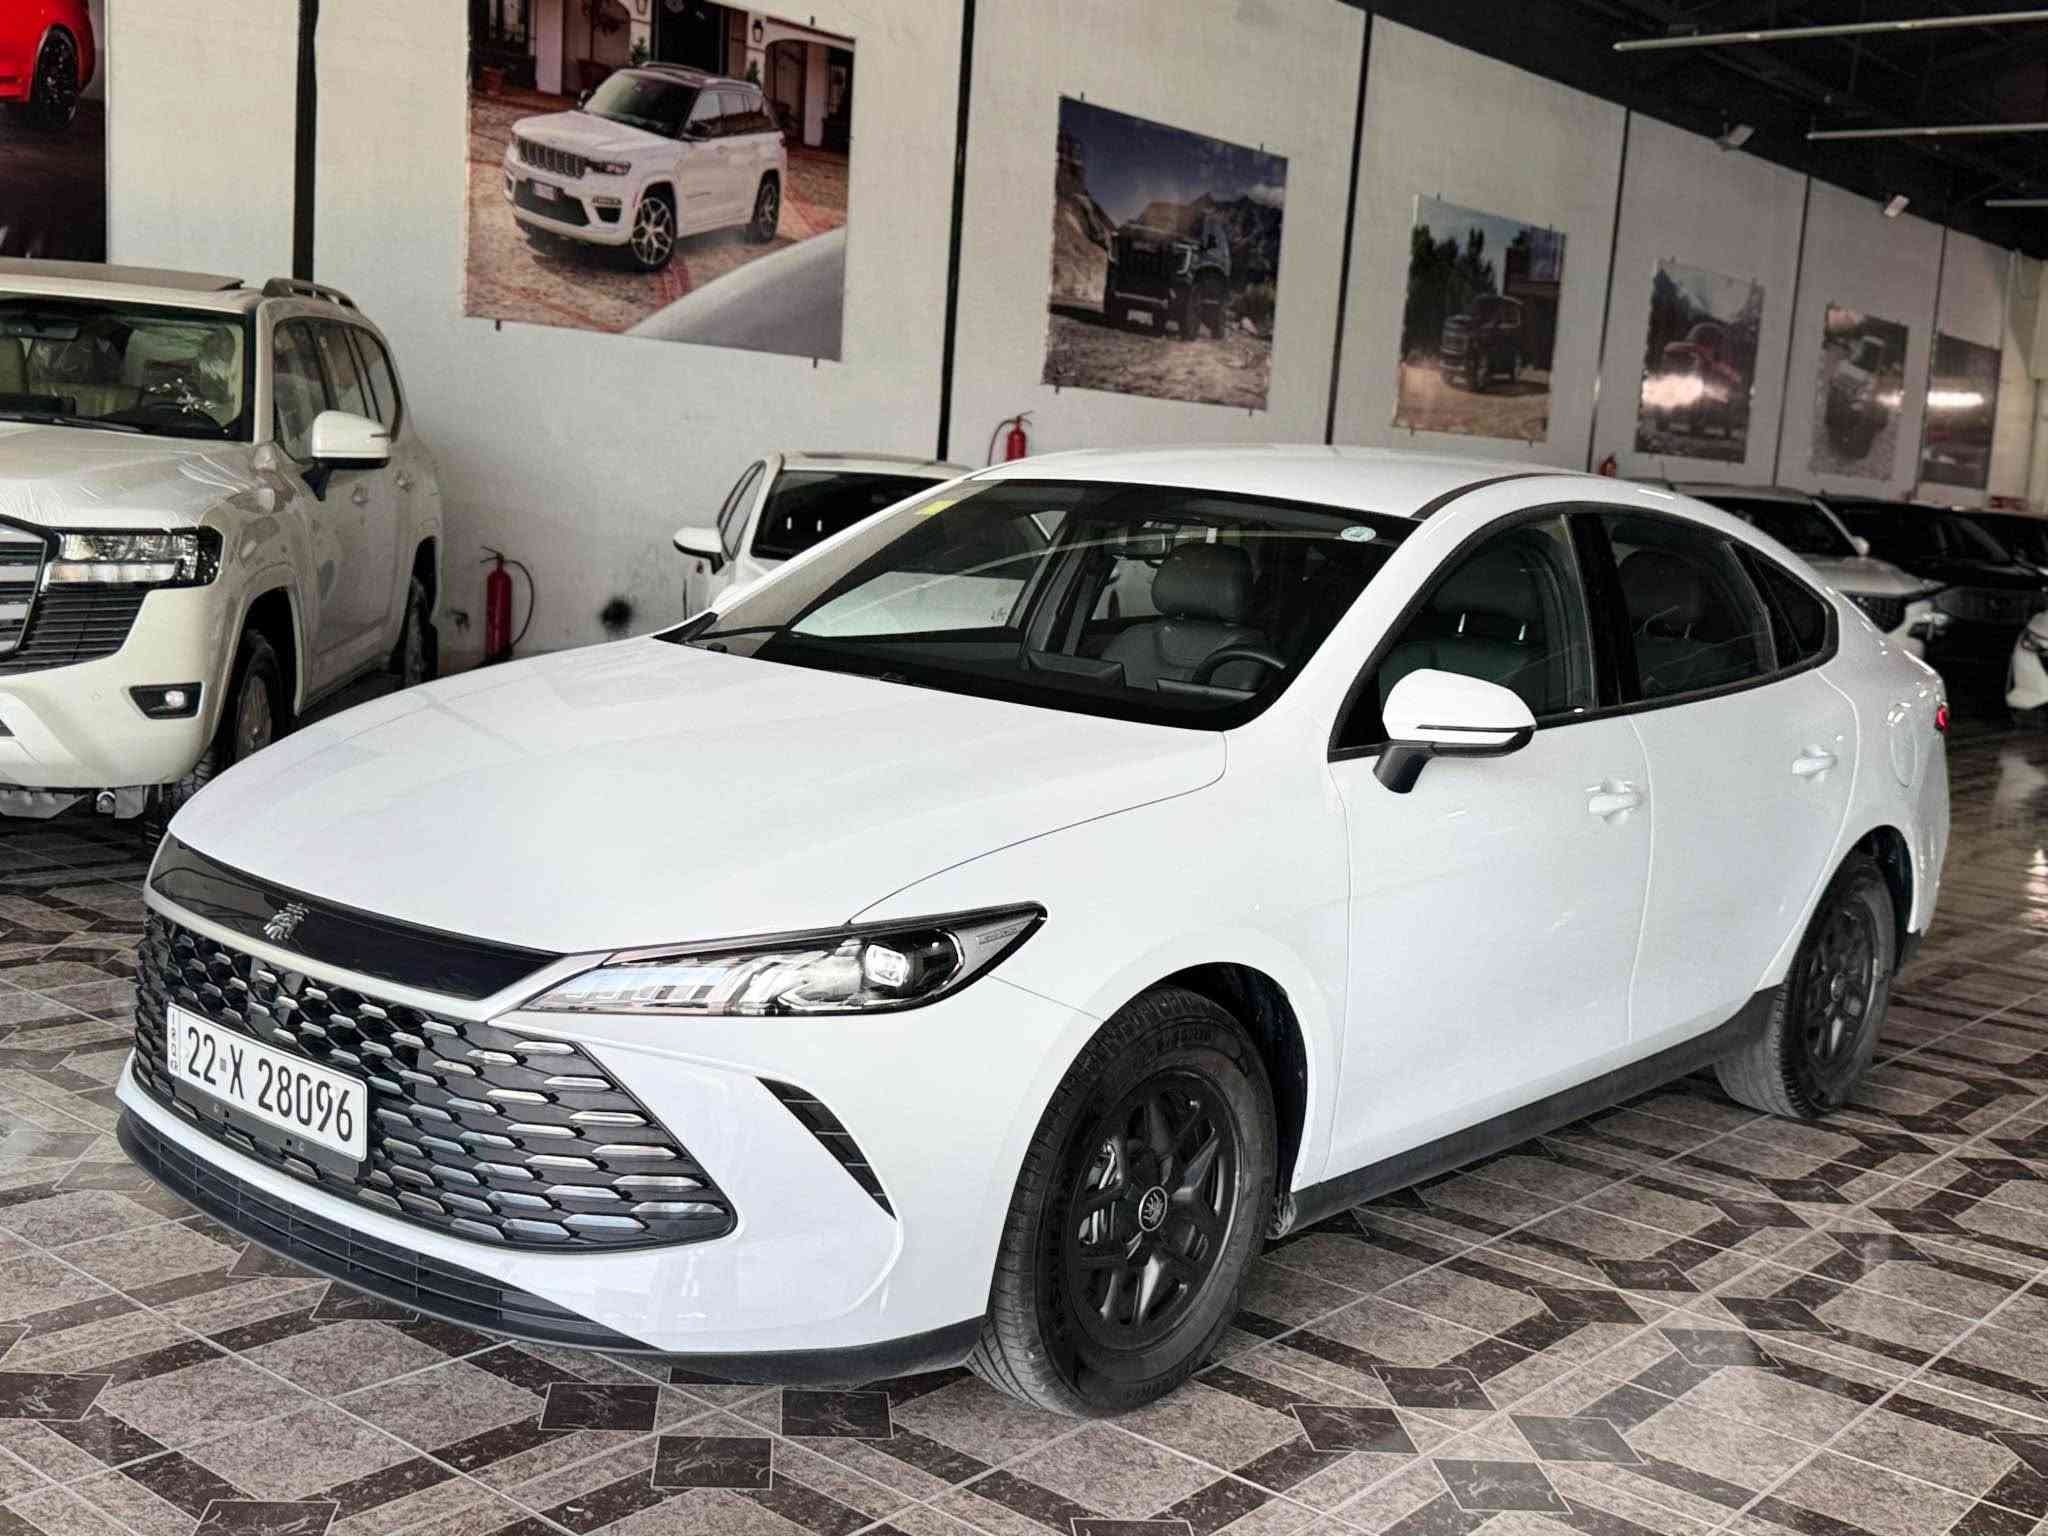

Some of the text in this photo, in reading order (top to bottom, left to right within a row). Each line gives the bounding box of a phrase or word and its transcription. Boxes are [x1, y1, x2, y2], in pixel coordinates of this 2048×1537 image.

[188, 1026, 353, 1143] 22 X 28096
